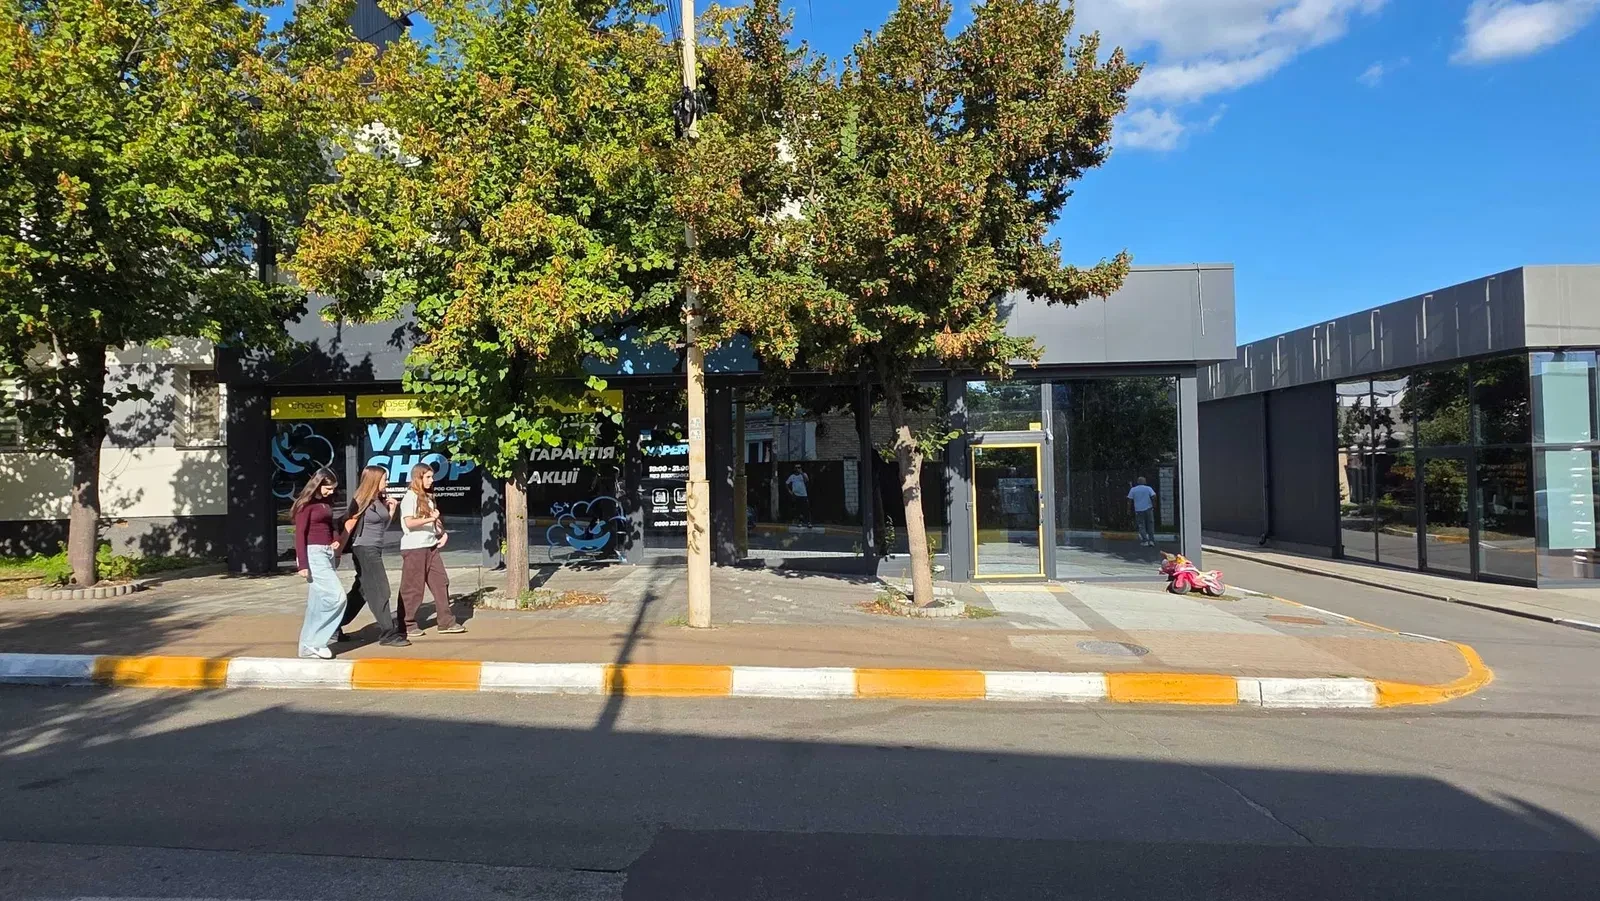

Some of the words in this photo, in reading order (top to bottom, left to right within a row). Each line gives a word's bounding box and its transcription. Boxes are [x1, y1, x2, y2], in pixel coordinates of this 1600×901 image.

[367, 421, 471, 452] VAP
[529, 446, 615, 461] ГАРАНТІЯ
[527, 467, 580, 486] АКЦІЇ
